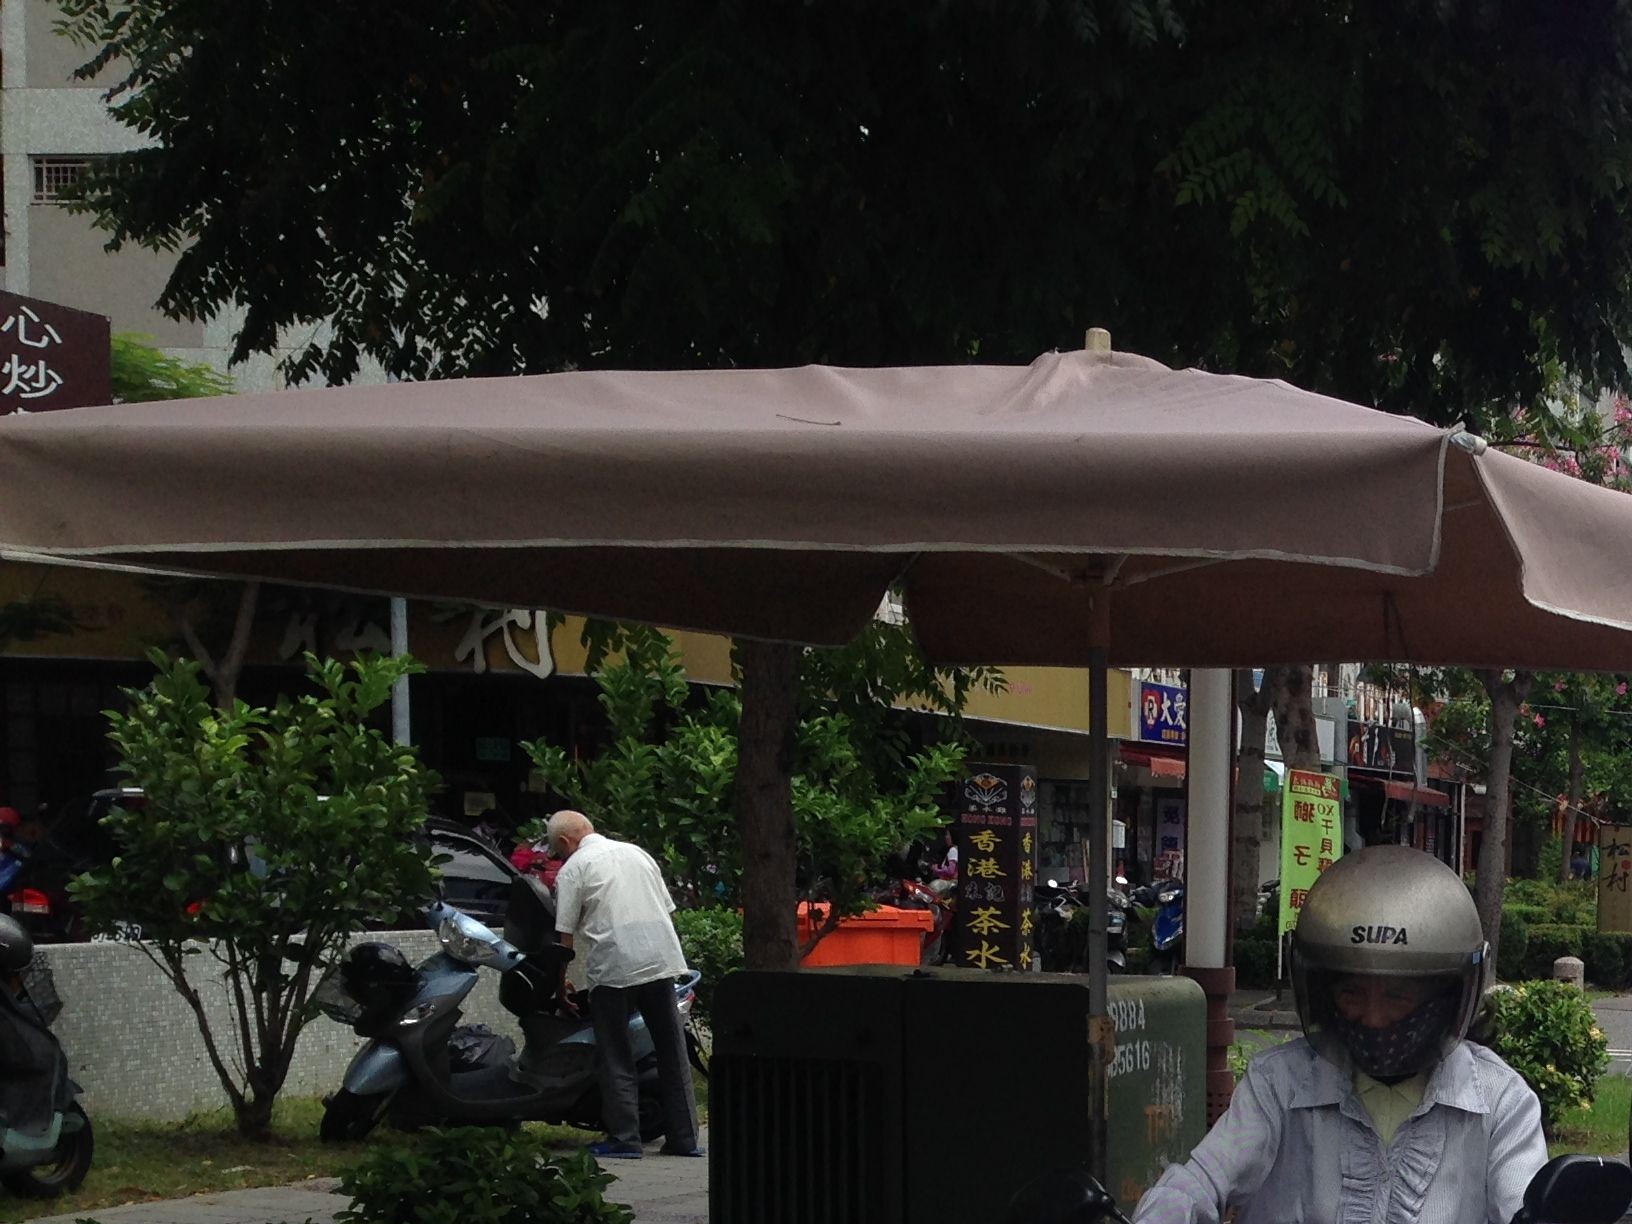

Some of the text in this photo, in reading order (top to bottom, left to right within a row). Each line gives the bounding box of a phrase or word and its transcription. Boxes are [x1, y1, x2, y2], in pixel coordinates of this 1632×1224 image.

[1, 305, 64, 415] 心炒
[967, 829, 1008, 879] 香港
[965, 906, 1012, 969] 茶水
[1350, 925, 1409, 946] SUPA
